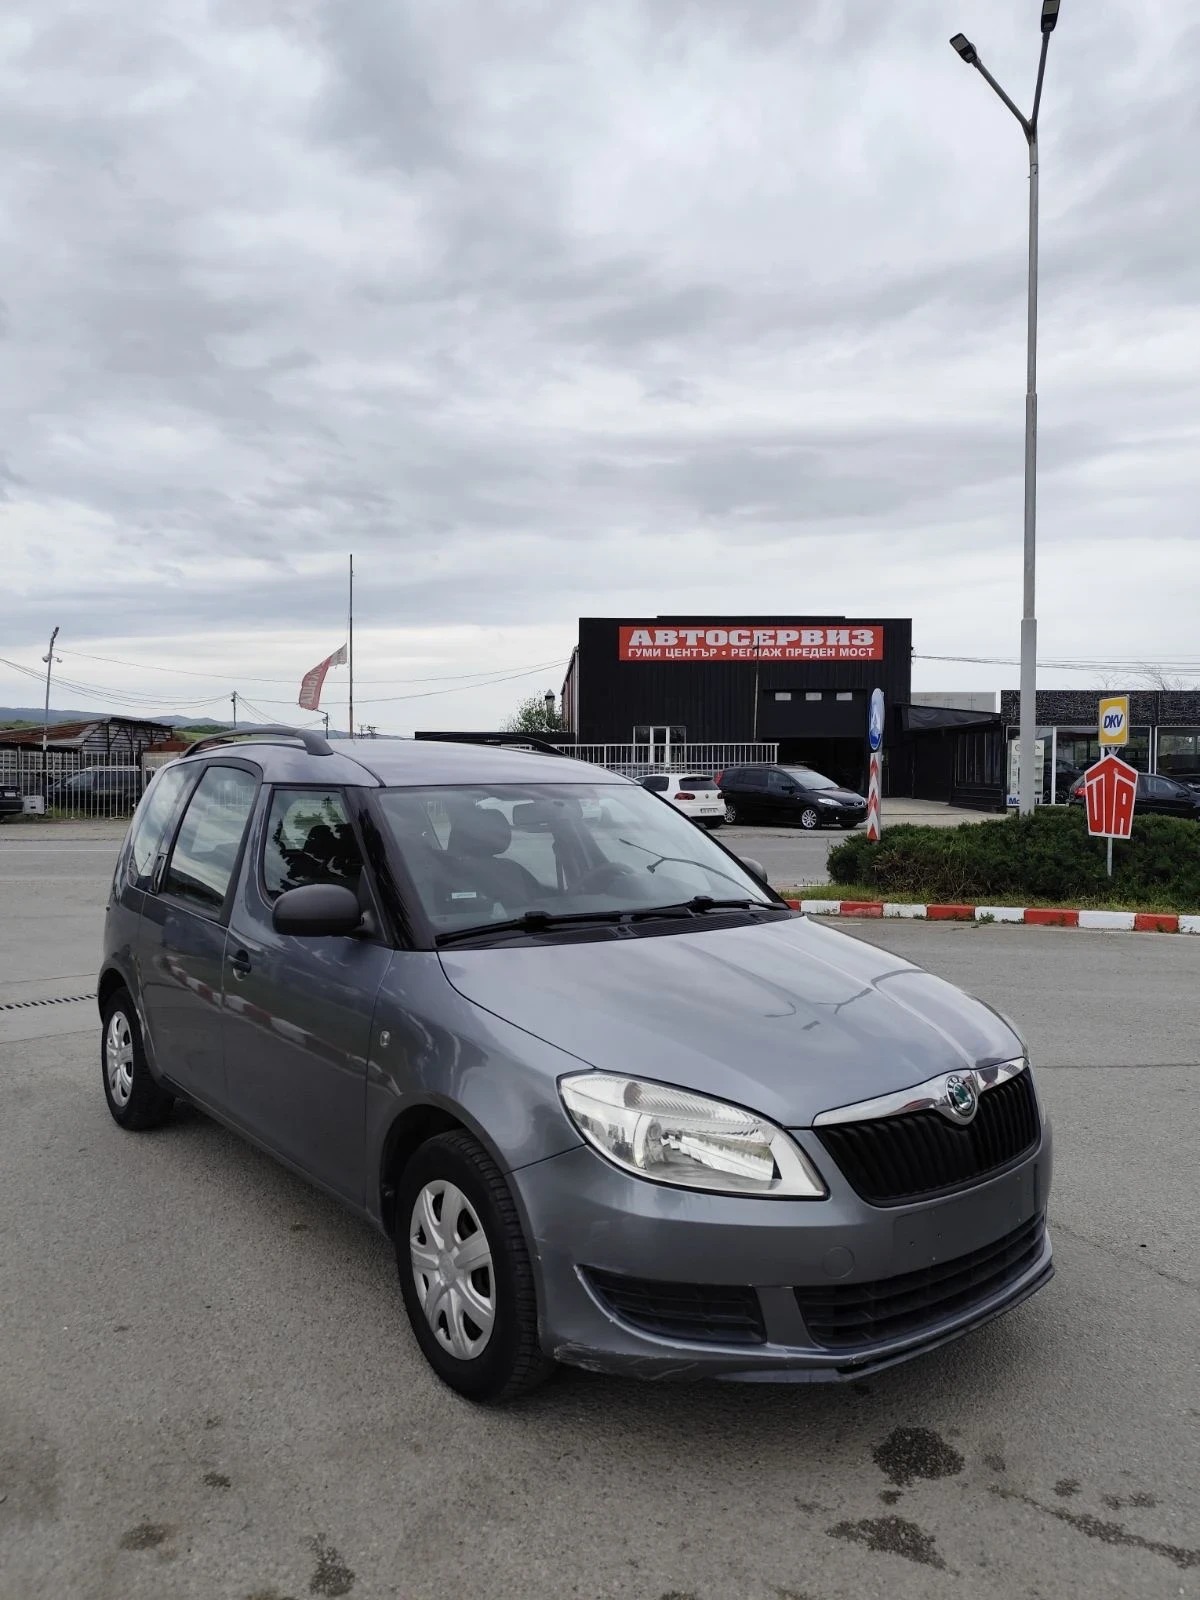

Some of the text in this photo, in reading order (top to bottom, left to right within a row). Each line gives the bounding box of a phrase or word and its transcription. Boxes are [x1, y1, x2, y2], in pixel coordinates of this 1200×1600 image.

[628, 629, 874, 646] АВТОСЕРВИЗ
[628, 648, 874, 658] ГУМИ ЦЕНТЪР РЕГЛАЖ ПРЕДЕН МОСТ
[1103, 714, 1124, 729] DKV
[1085, 756, 1137, 836] UTA
